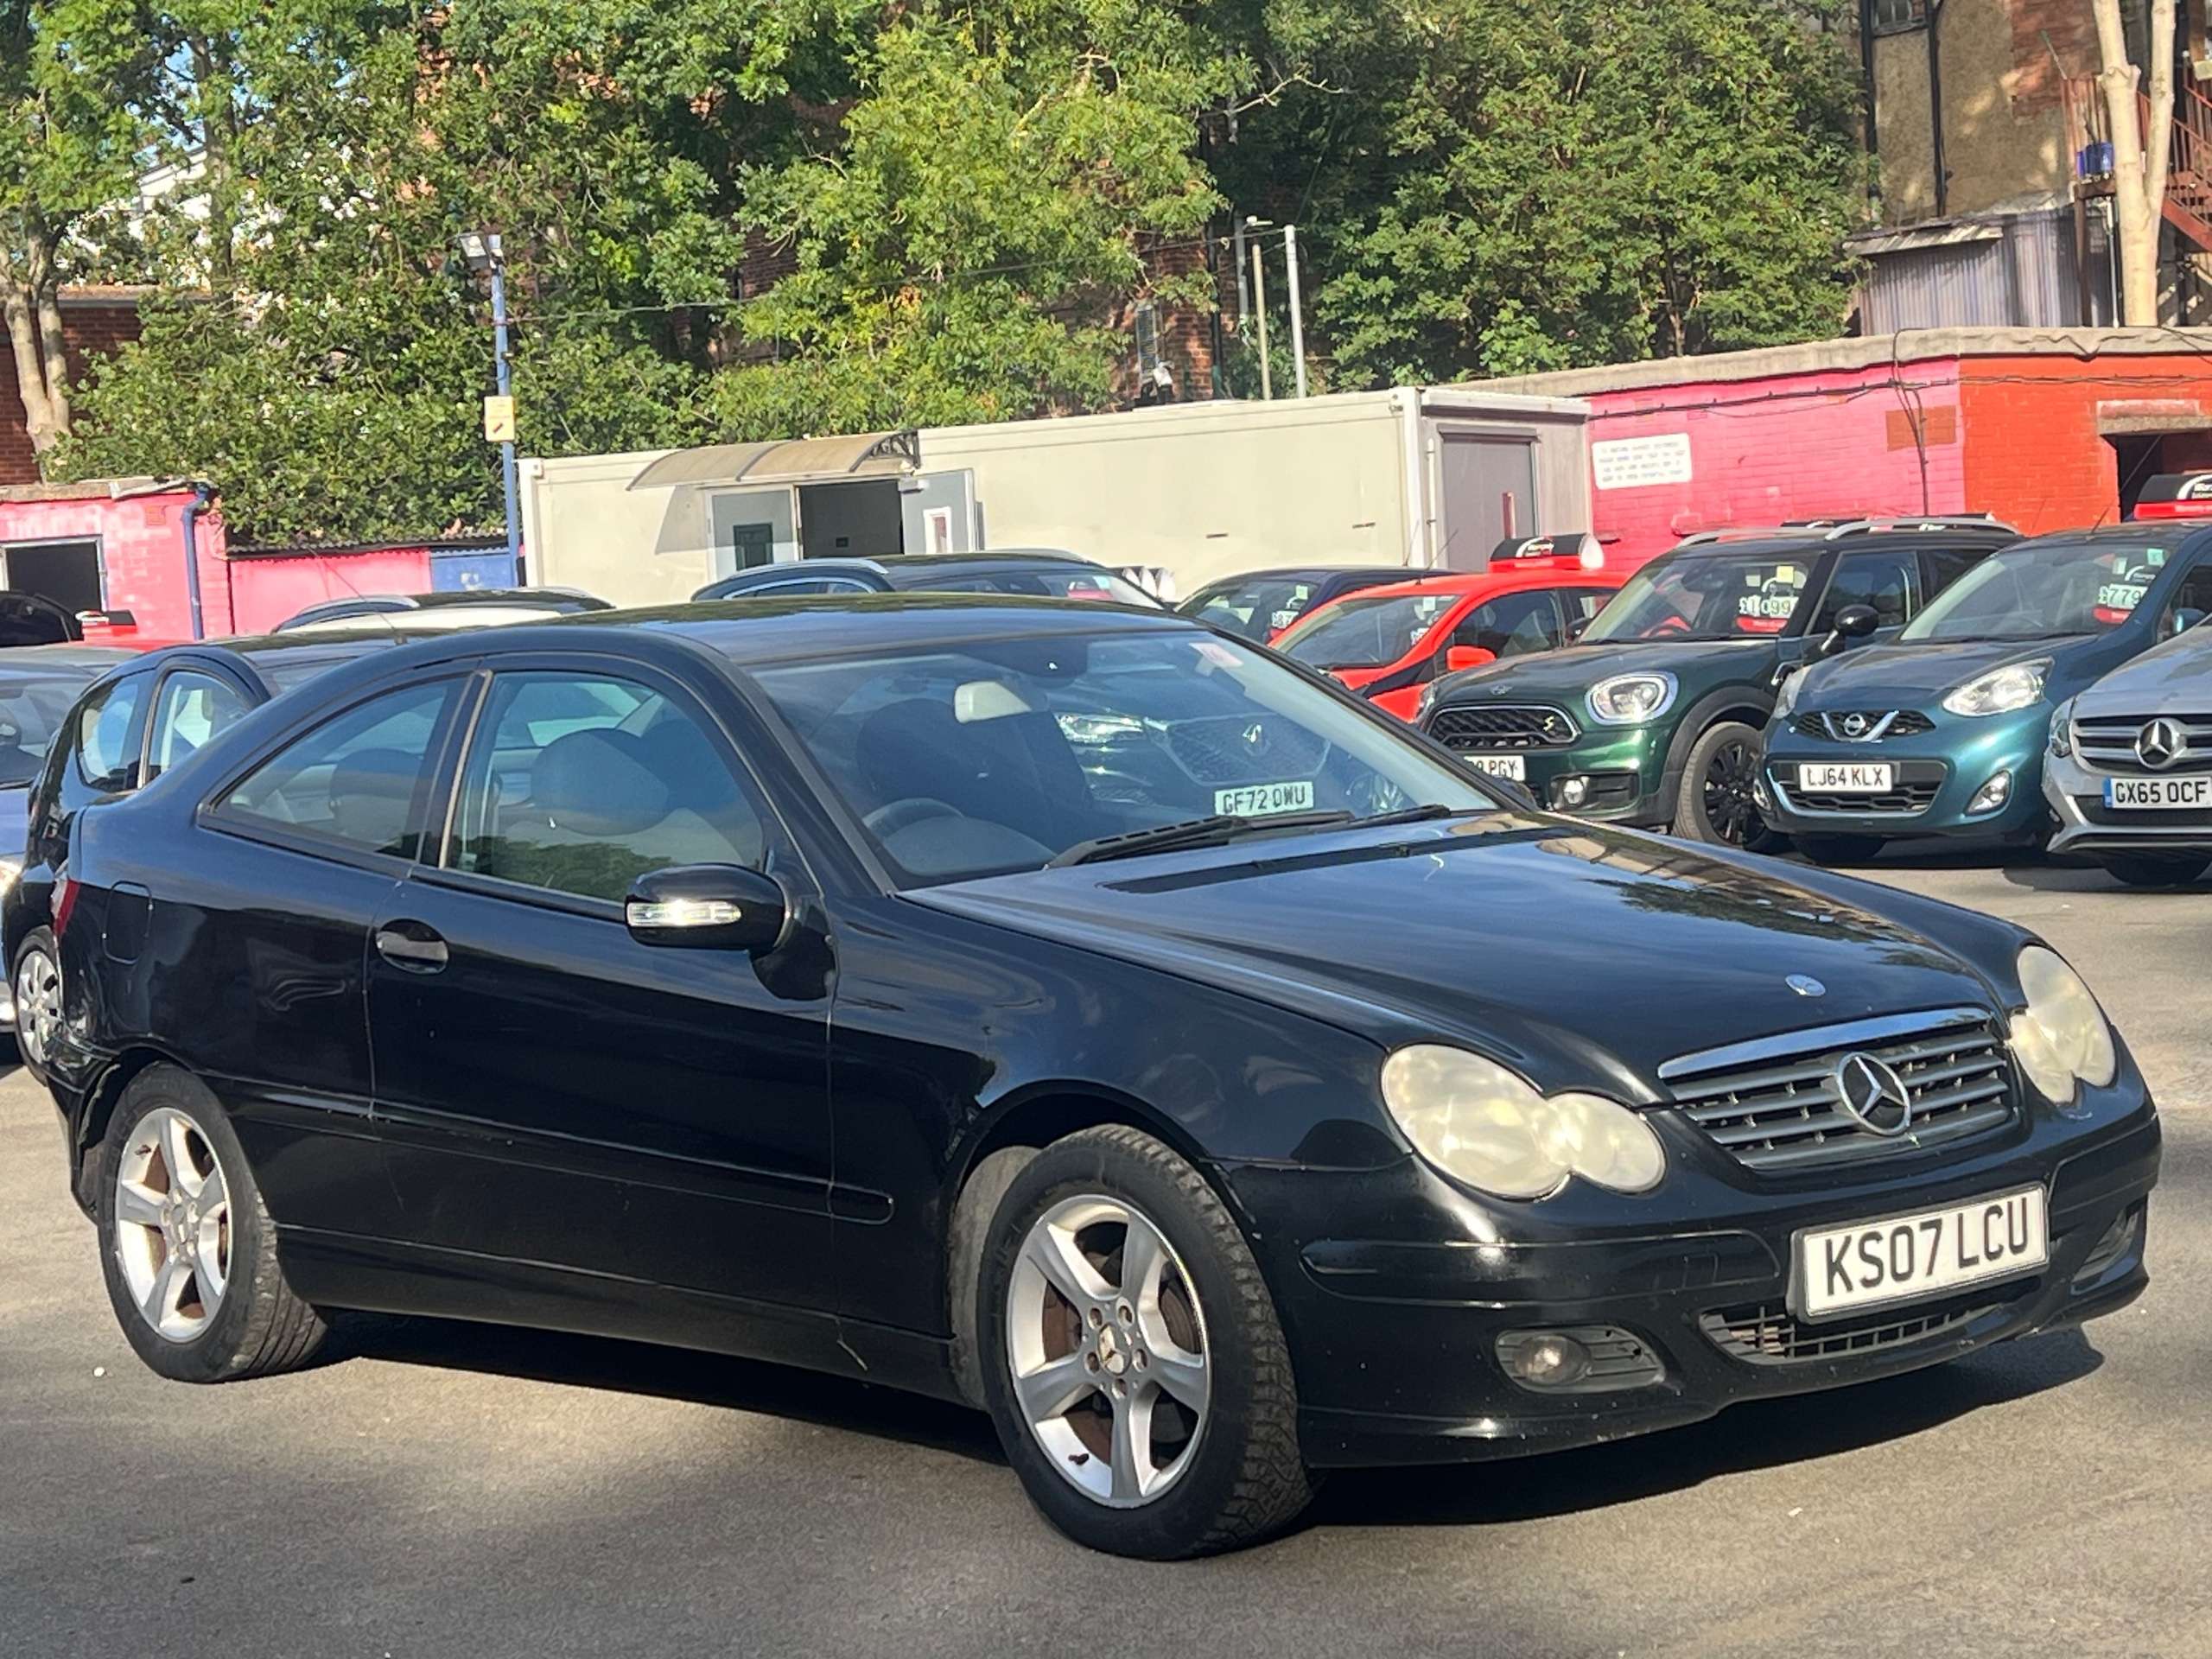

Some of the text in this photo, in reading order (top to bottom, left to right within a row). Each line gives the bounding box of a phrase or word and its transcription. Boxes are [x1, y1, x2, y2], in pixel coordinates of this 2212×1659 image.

[1807, 766, 1884, 786] LJ64 KLX
[1223, 789, 1268, 814] GF72
[2115, 781, 2209, 804] GX65 OCF
[1825, 1197, 2028, 1296] KS07 LCU
